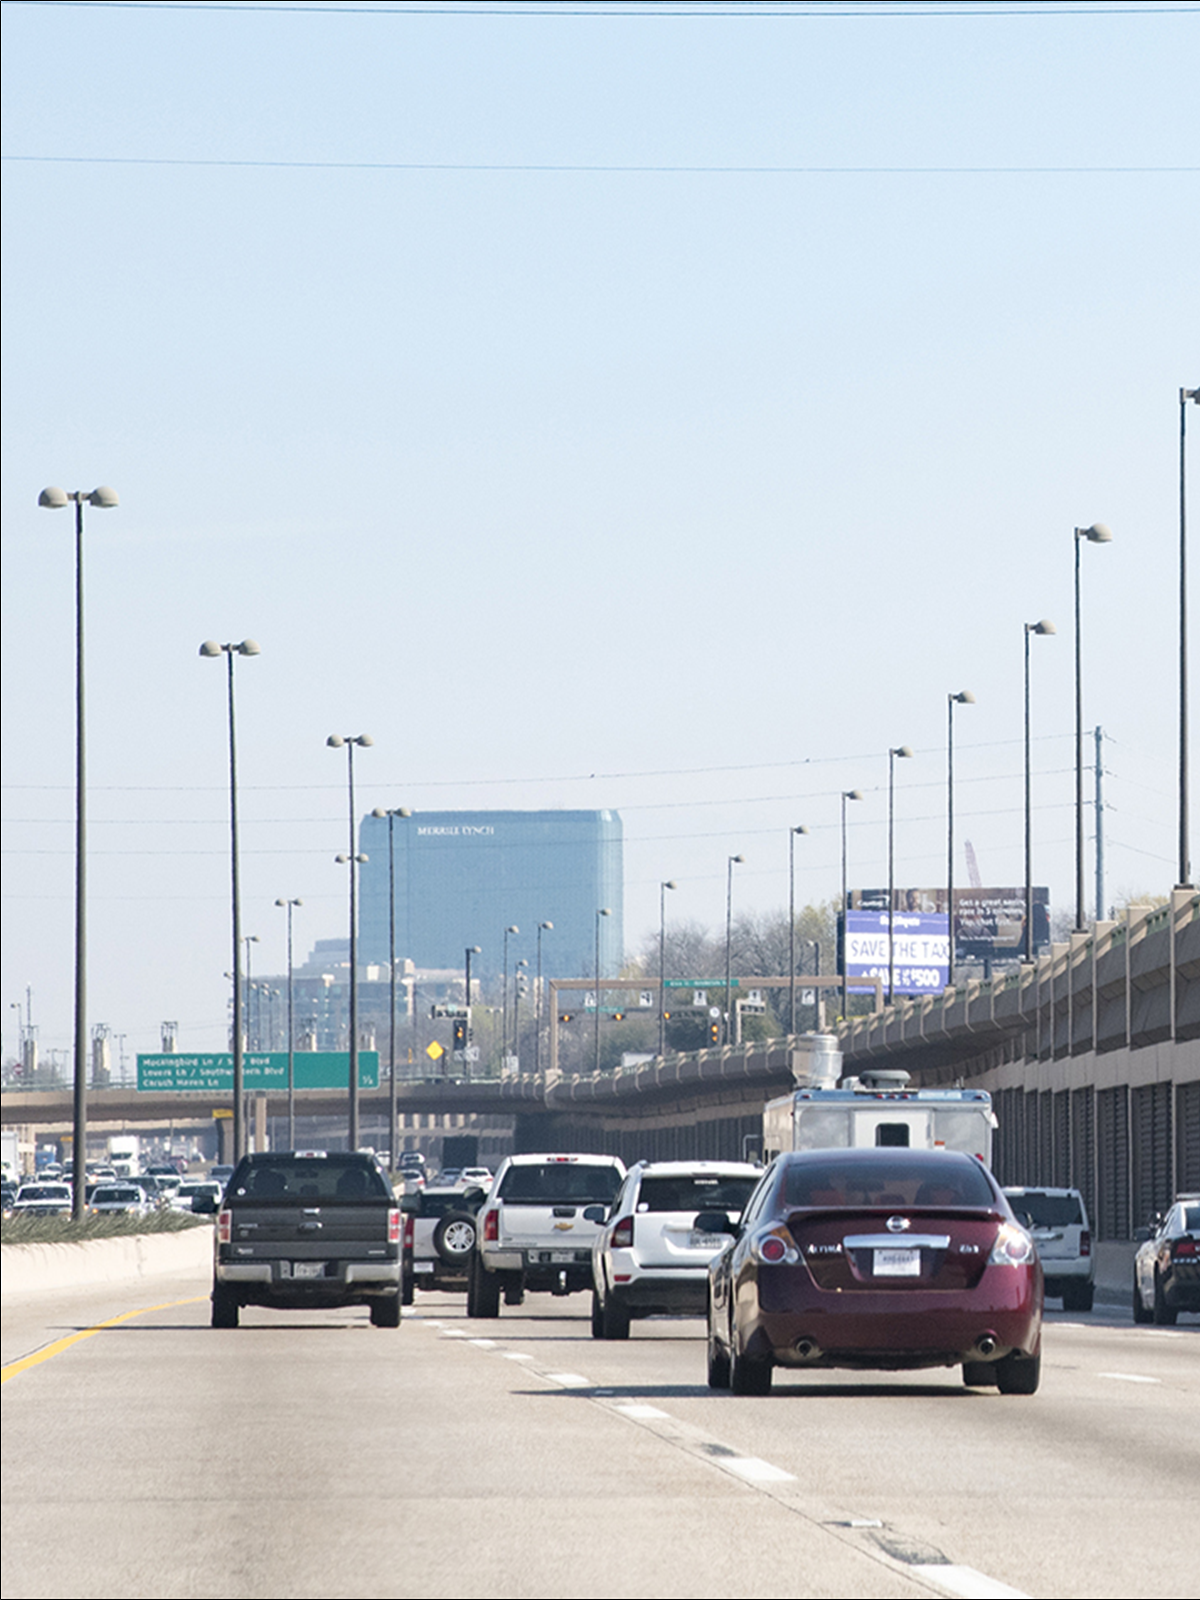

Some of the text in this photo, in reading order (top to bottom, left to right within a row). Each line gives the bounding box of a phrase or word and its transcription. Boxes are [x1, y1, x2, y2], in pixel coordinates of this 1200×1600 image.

[850, 939, 951, 959] SAVE THE TAX
[142, 1057, 199, 1068] Mockingbird
[199, 1067, 261, 1077] Southwtern
